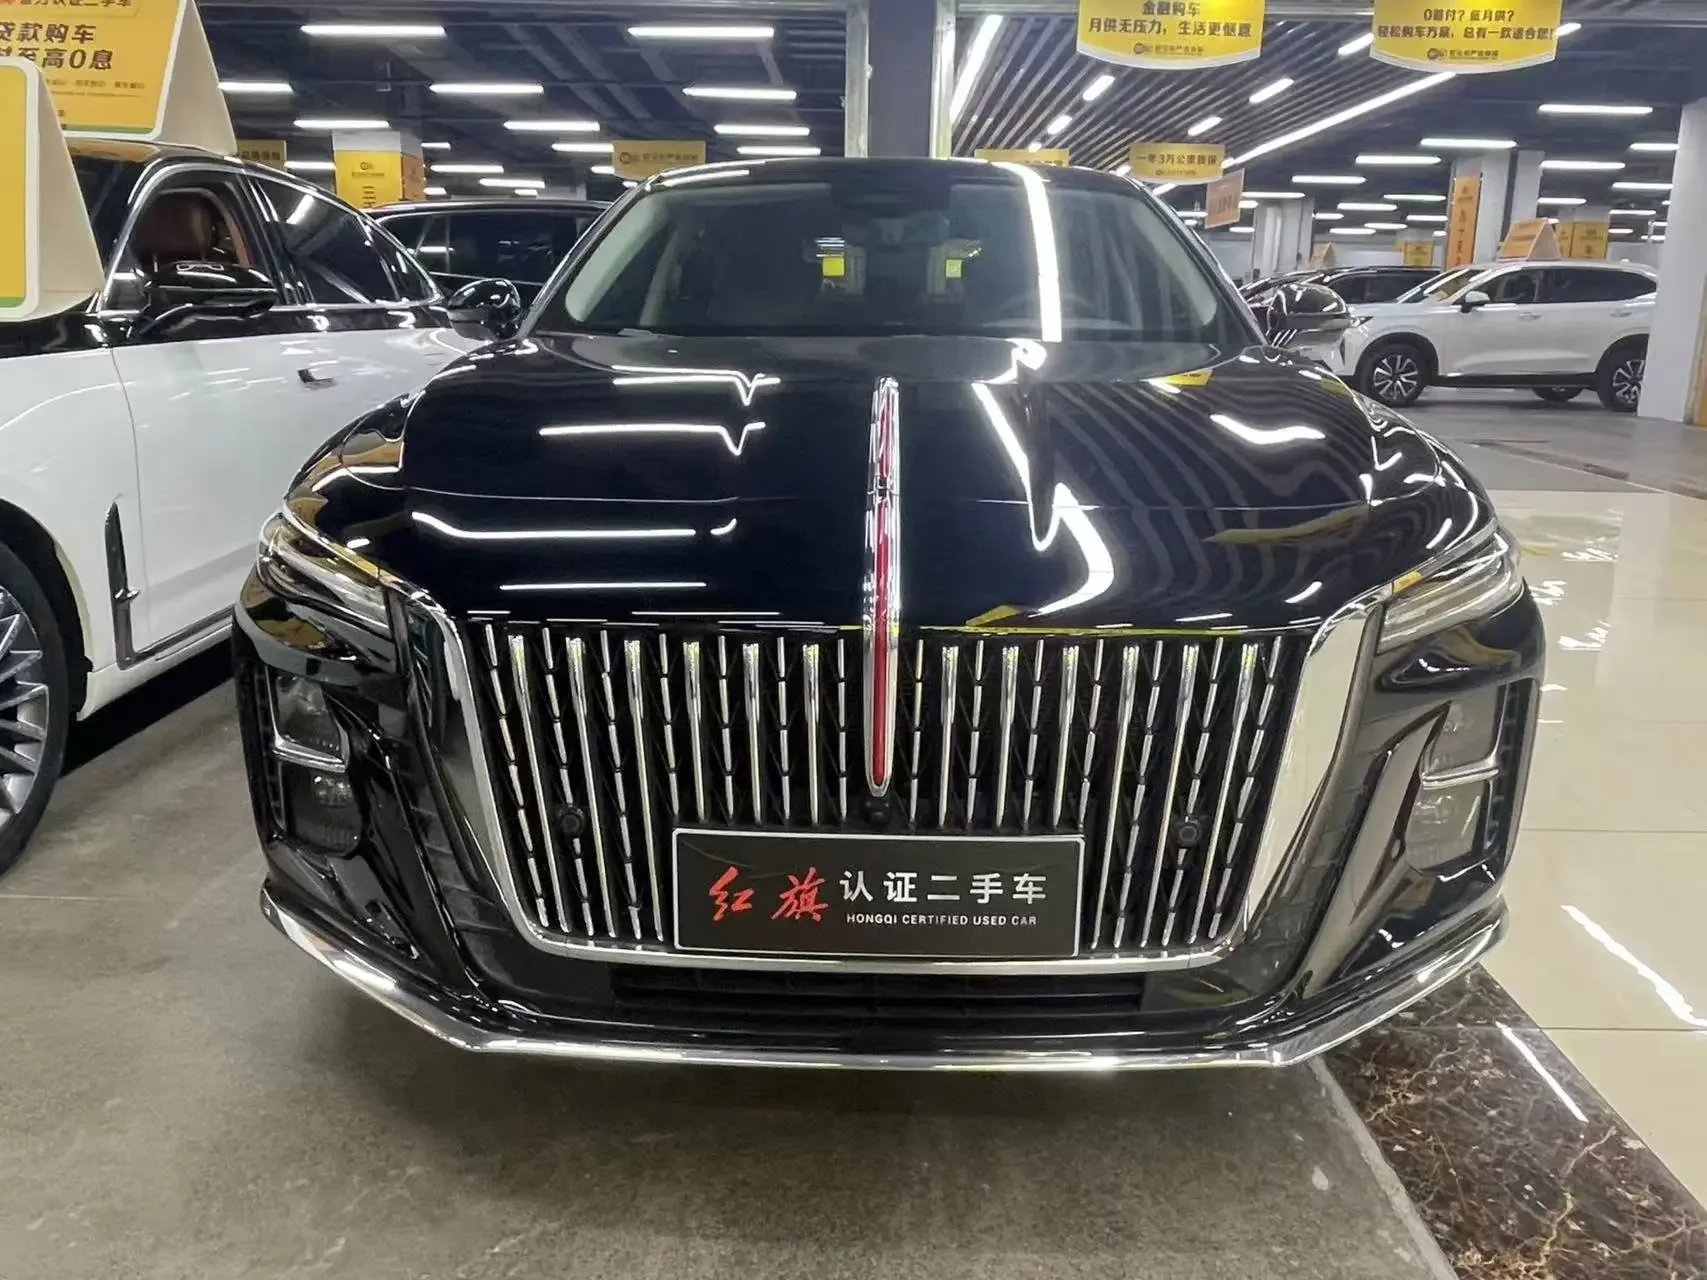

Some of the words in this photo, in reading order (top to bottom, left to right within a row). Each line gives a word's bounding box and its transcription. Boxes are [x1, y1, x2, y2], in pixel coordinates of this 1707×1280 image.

[0, 21, 97, 45] 贷款购车
[708, 866, 831, 922] 红旗
[839, 870, 1047, 905] 认证二手车
[846, 913, 898, 925] HONGQI
[902, 914, 968, 926] CERTIFIED
[972, 914, 1007, 926] USED
[1011, 915, 1038, 926] CAR
